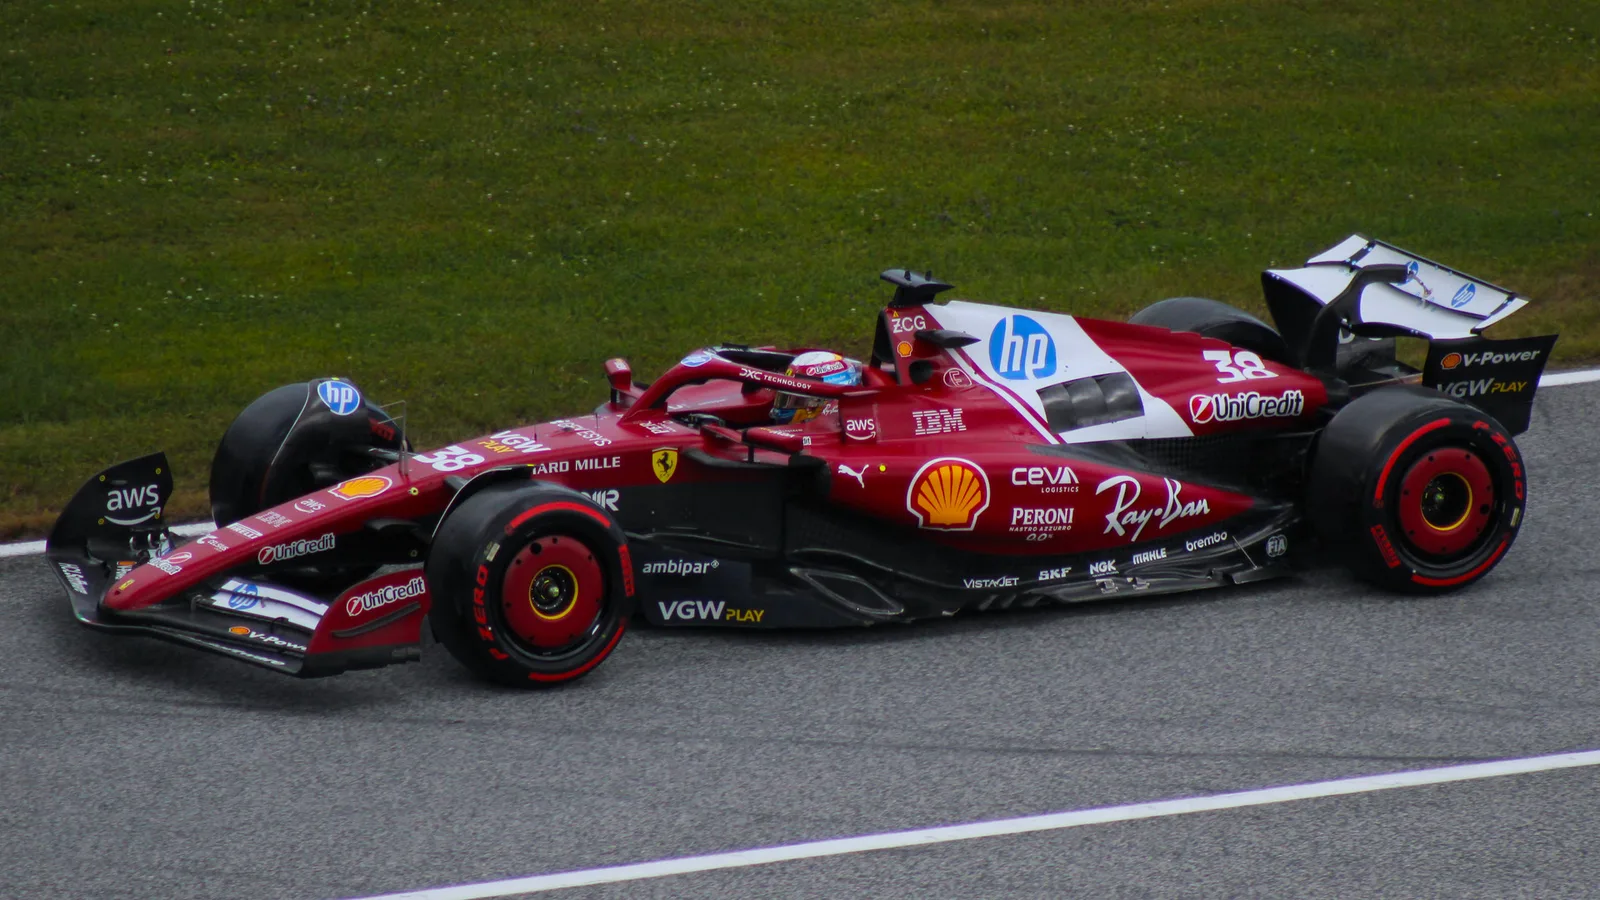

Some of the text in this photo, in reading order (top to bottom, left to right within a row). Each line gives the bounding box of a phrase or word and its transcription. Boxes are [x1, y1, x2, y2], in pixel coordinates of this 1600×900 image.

[991, 314, 1056, 383] hp
[1202, 350, 1279, 384] 38
[1463, 350, 1541, 368] V-Power
[739, 367, 764, 381] DXC
[763, 375, 812, 391] TECHNOLOGY
[1491, 382, 1528, 394] PLAY
[322, 380, 357, 415] hp
[1212, 389, 1305, 421] UniCredit
[846, 418, 876, 434] aws
[911, 407, 967, 436] IBM
[477, 440, 516, 453] PLAY
[489, 430, 552, 453] VGW
[411, 445, 486, 472] 38
[575, 456, 621, 471] MILLE
[107, 483, 160, 512] aws
[1041, 486, 1080, 494] LOGISTICS
[297, 499, 326, 513] aws
[1011, 507, 1075, 525] PERONI
[1038, 525, 1073, 533] AZZURRO
[273, 532, 337, 562] UniCredit
[1186, 531, 1229, 552] brembo
[1266, 535, 1288, 558] FIA
[1131, 547, 1168, 565] MAHLE
[642, 559, 711, 577] ambipar
[1038, 567, 1073, 581] SKF
[1089, 558, 1117, 575] NGK
[962, 576, 1021, 589] VISTAJET
[362, 576, 427, 612] UniCredit
[657, 600, 765, 622] VGW PLAY
